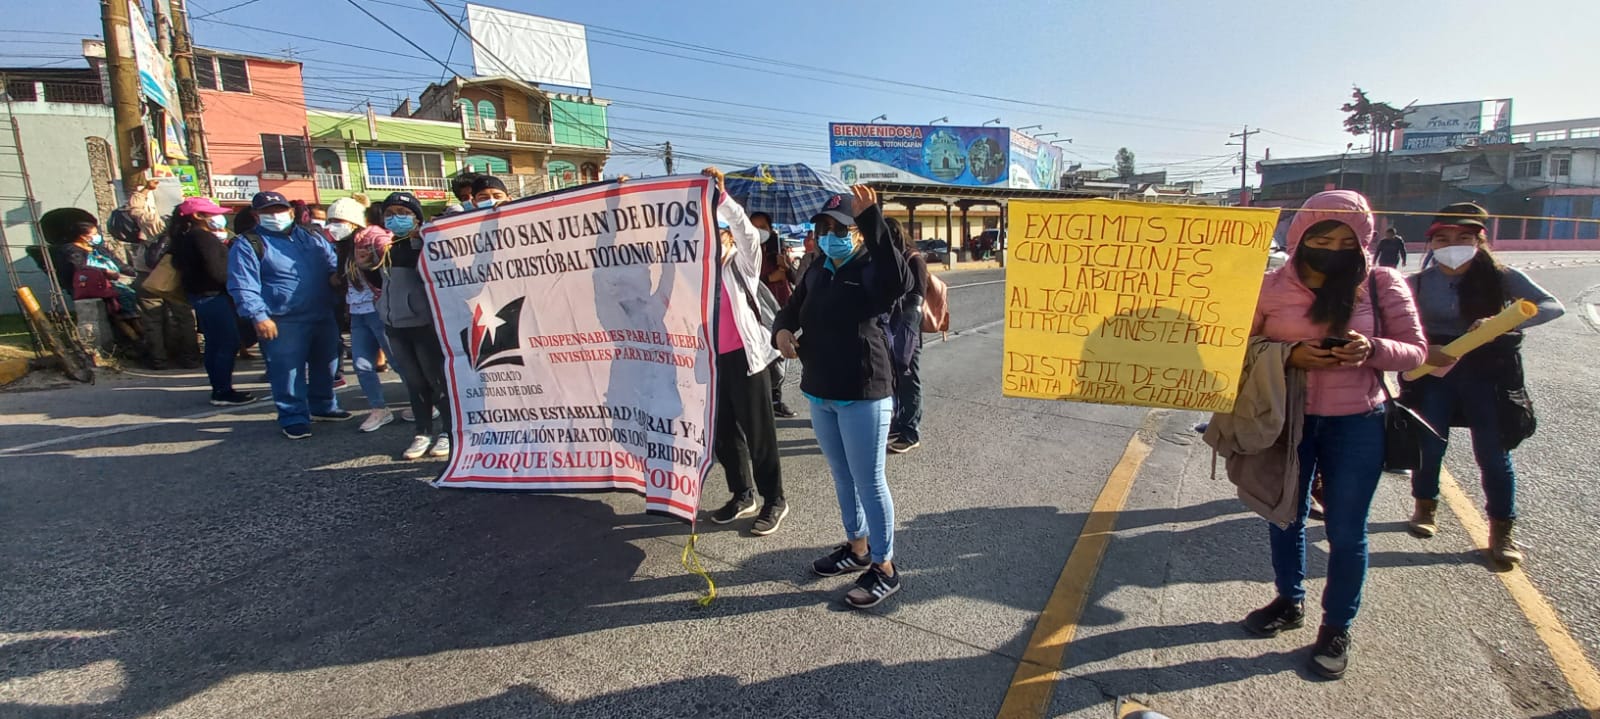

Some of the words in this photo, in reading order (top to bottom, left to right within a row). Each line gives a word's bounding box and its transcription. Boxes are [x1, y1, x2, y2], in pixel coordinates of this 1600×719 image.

[833, 125, 912, 138] BIENVENIDOS
[912, 126, 922, 138] A
[428, 226, 515, 262] SINDICATO
[518, 220, 554, 246] SAN
[557, 209, 610, 241] JUAN
[611, 205, 641, 232] DE
[641, 201, 699, 228] DIOS
[1024, 214, 1168, 244] EXIGIMOS
[1173, 216, 1274, 252] IGUALDAD
[433, 263, 478, 289] FILIAL
[478, 260, 504, 283] SAN
[506, 247, 588, 279] CRISTÓBAL
[587, 234, 699, 271] TOTONICAPÁN
[1014, 240, 1213, 275] CONDICIONES
[1063, 266, 1211, 299] LABORALES
[1010, 286, 1030, 309] AL
[1039, 288, 1100, 315] IGUAL
[1115, 294, 1167, 321] QUE
[1176, 296, 1221, 324] LOS
[528, 329, 625, 348] INDISPENSABLES
[625, 329, 651, 343] PARA
[652, 331, 665, 345] EL
[1009, 311, 1089, 336] OTROS
[1101, 316, 1248, 348] MINISTERIOS
[548, 348, 612, 364] INVISIBLES
[1008, 351, 1121, 384] DISTRITO
[1127, 363, 1159, 386] DE
[479, 371, 521, 382] SINDICATO
[507, 385, 520, 396] DE
[520, 384, 543, 395] DIOS
[1004, 374, 1061, 393] SANTA
[1071, 379, 1125, 400] MARIA
[467, 408, 541, 425] EXIGIMOS
[541, 405, 632, 421] ESTABILIDAD
[680, 420, 692, 438] Y
[470, 425, 555, 447] DIGNIFICACIÓN
[557, 428, 588, 444] PARA
[589, 427, 627, 443] TODOS
[552, 450, 613, 469] SALUD
